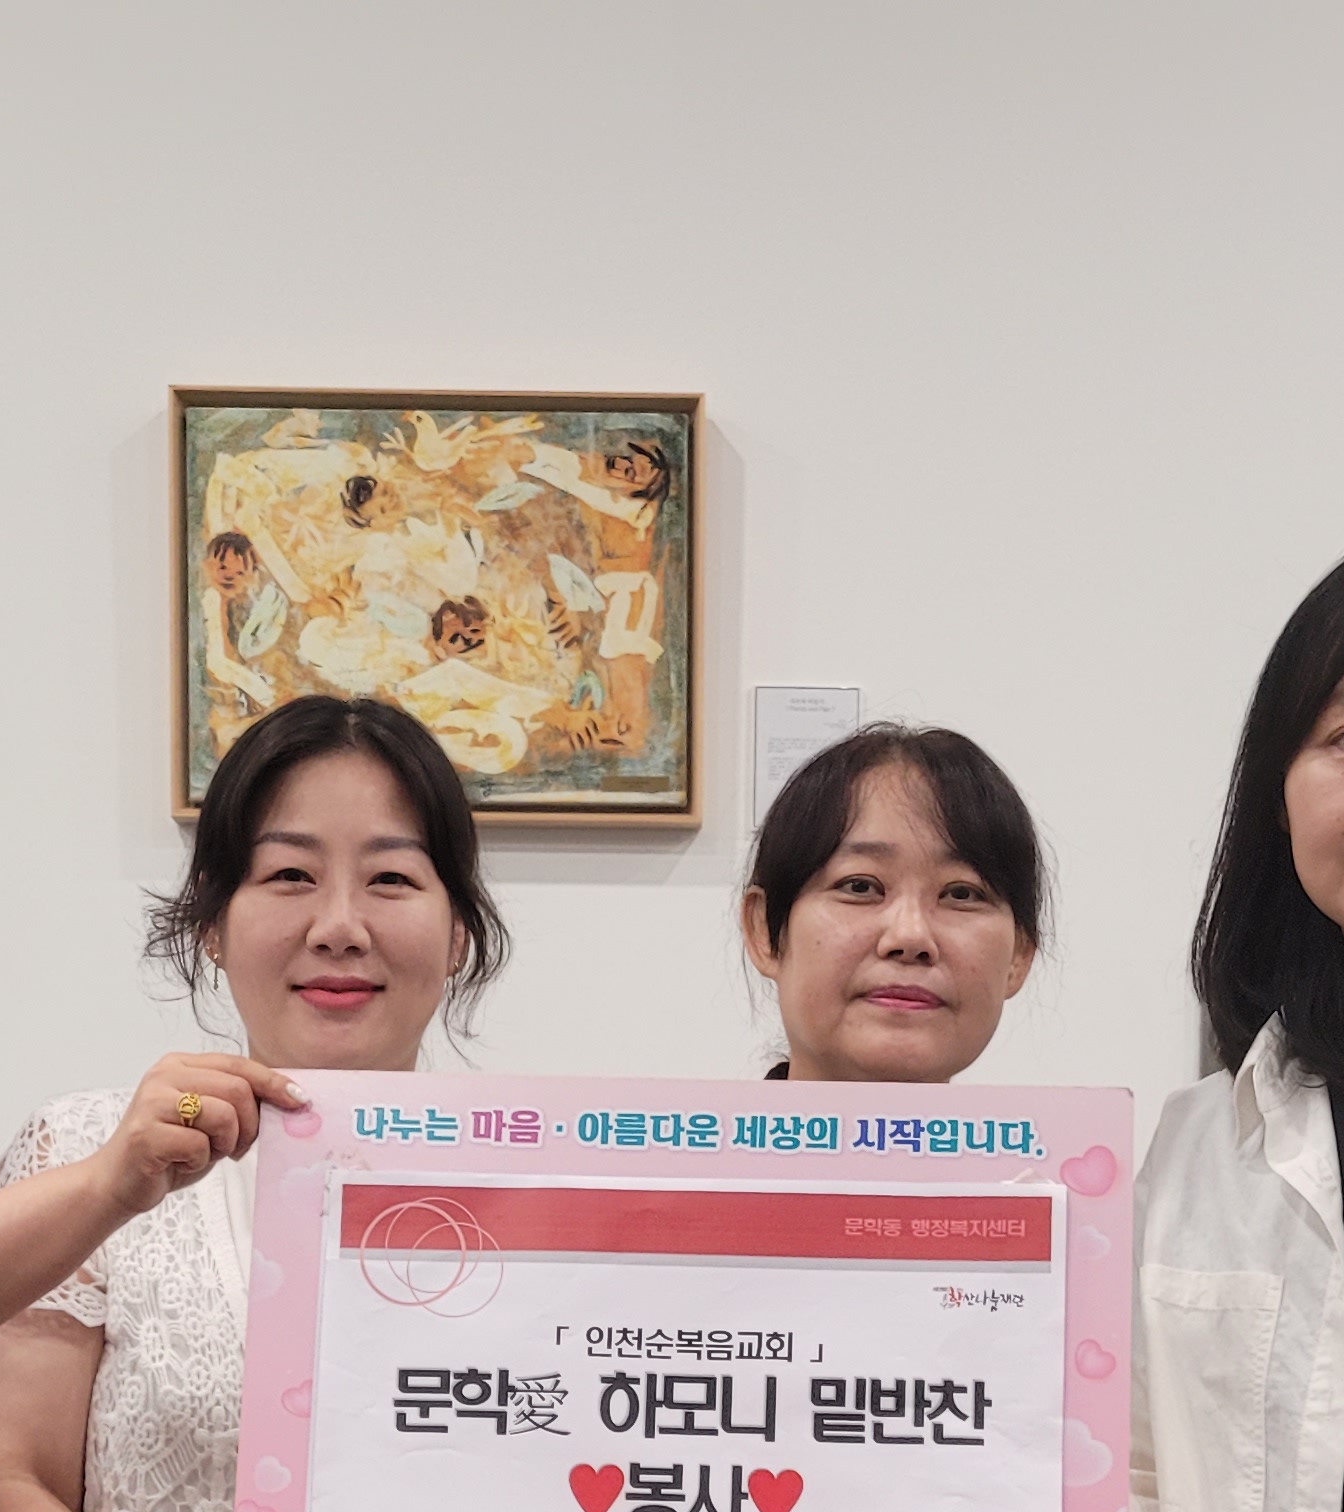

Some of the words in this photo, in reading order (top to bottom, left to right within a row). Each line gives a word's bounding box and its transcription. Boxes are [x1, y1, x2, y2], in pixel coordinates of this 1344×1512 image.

[353, 1106, 459, 1143] 나누는
[470, 1109, 543, 1145] 마음
[577, 1111, 719, 1148] 아름다운
[732, 1115, 840, 1150] 세상의
[853, 1118, 1045, 1157] 시작입니다.
[844, 1217, 903, 1237] 문학동
[911, 1218, 1027, 1238] 행정복지센터
[585, 1326, 794, 1363] 인천순복음교회
[393, 1367, 572, 1436] 문학愛
[599, 1369, 777, 1442] 하모니
[809, 1375, 993, 1446] 밑반찬
